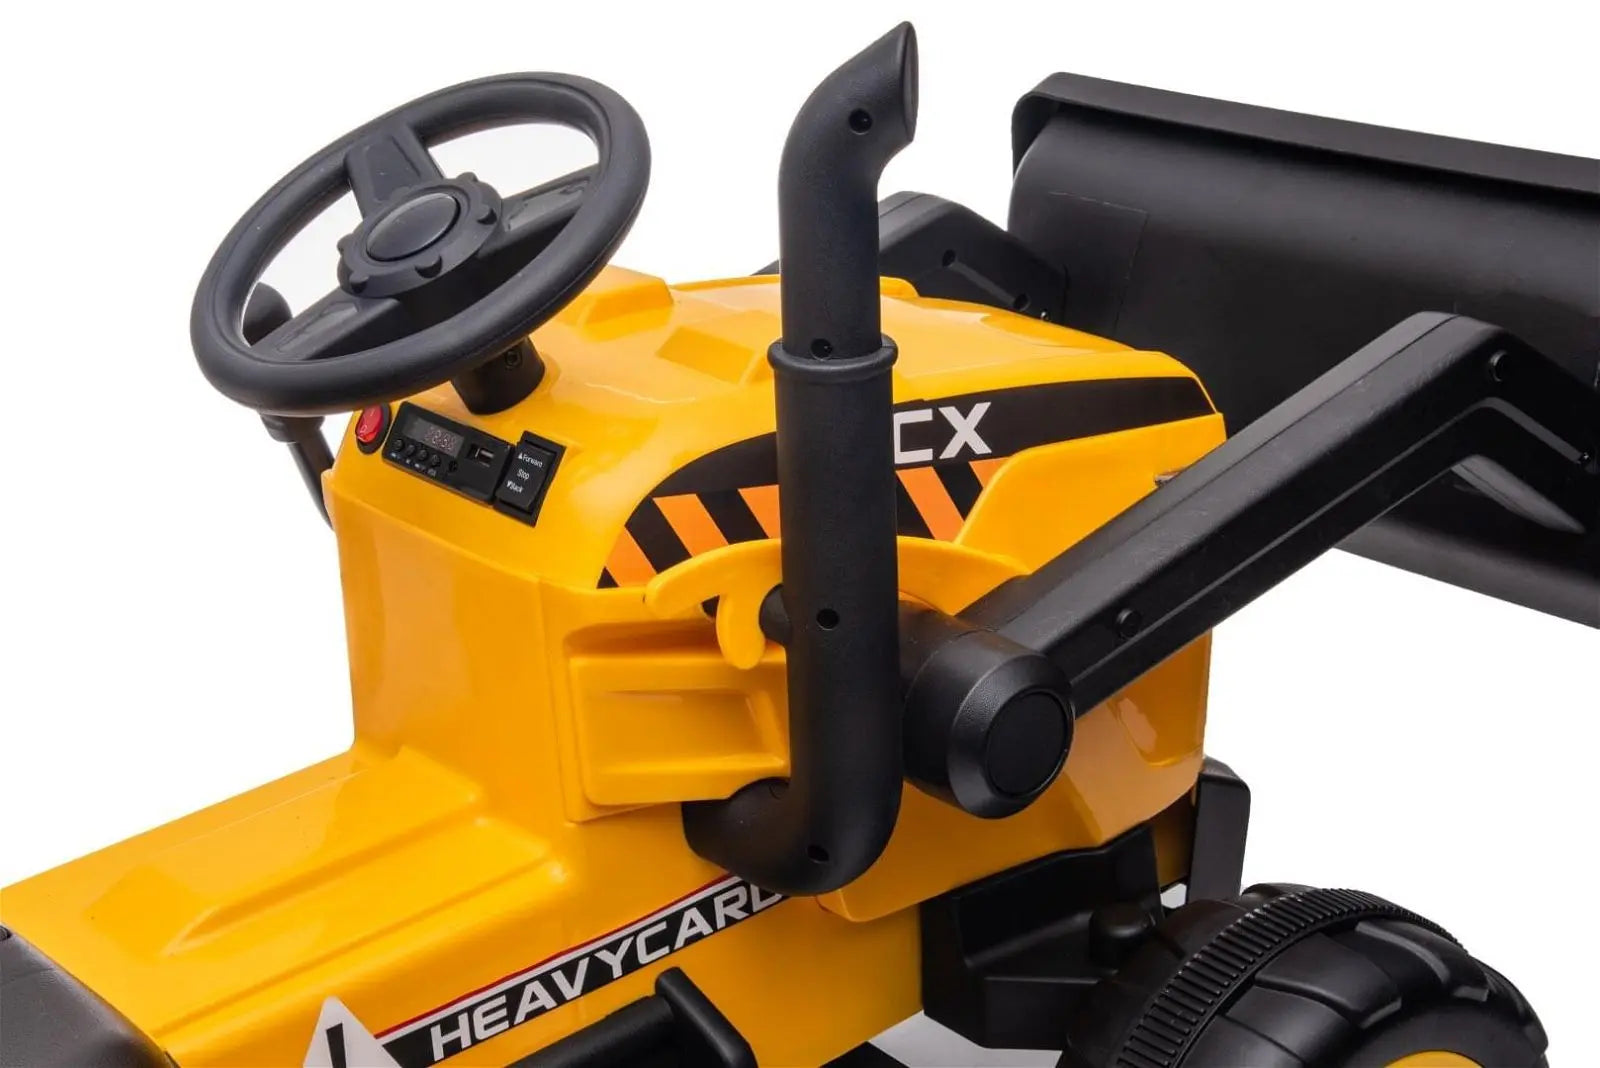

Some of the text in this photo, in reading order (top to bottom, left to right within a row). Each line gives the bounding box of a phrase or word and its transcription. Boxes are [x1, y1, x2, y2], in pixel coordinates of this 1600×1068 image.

[522, 453, 543, 468] Forward
[517, 468, 530, 481] Stop
[509, 481, 524, 493] Back
